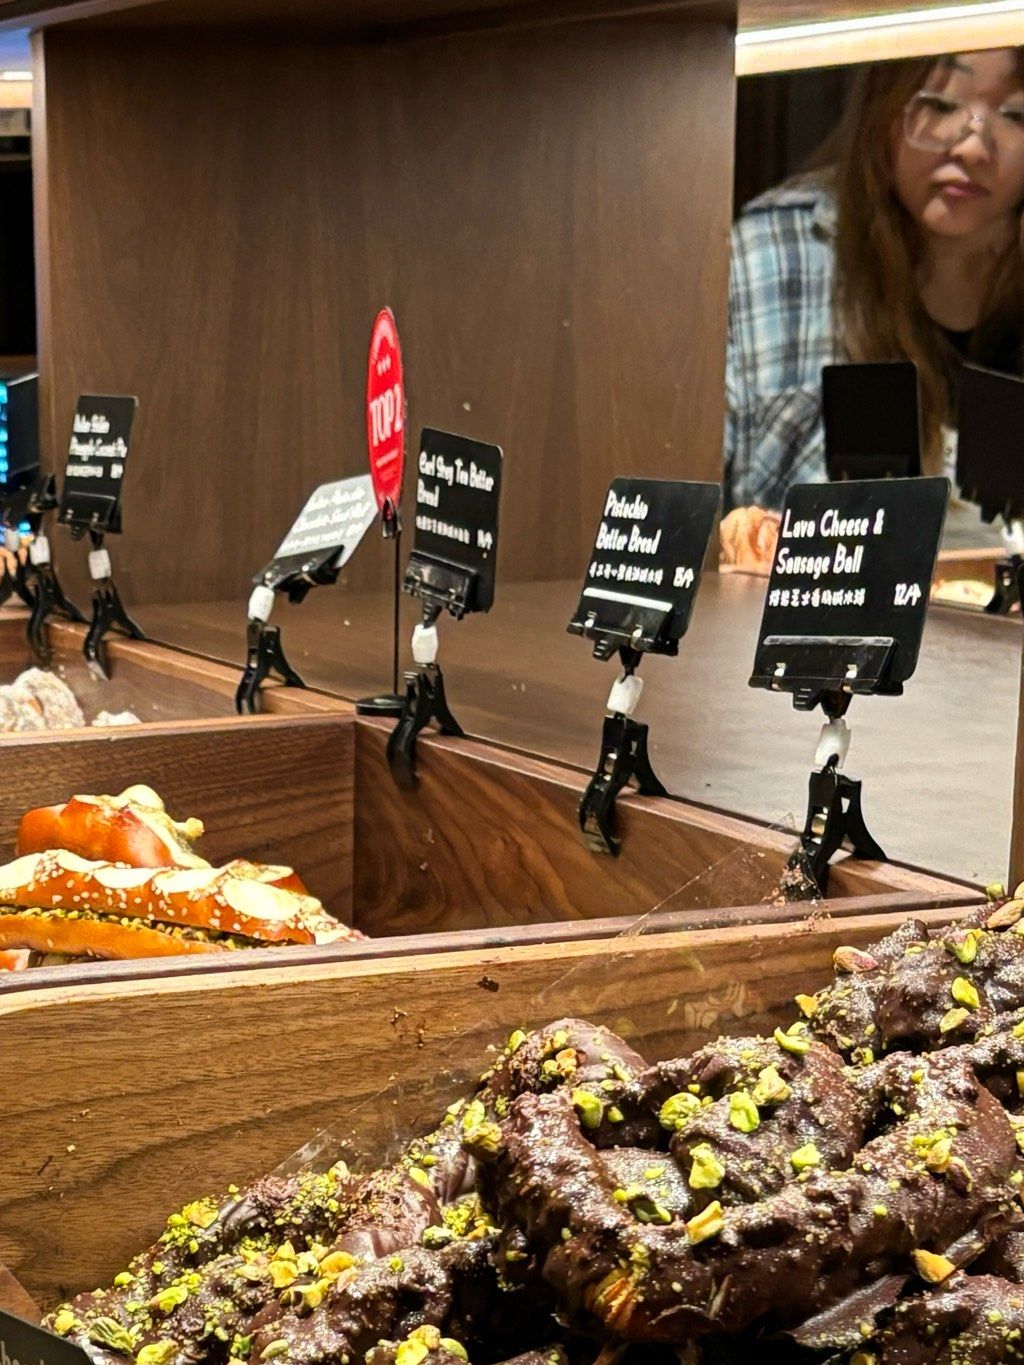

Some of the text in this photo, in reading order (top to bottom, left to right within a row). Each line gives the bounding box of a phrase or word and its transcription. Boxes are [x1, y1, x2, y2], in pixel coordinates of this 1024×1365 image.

[369, 388, 394, 447] TOP
[417, 478, 440, 508] Bread
[604, 489, 649, 520] Pistachio
[596, 522, 662, 555] Butter Bread
[782, 508, 885, 538] Lava Cheese &
[776, 543, 864, 580] Sausage Ball
